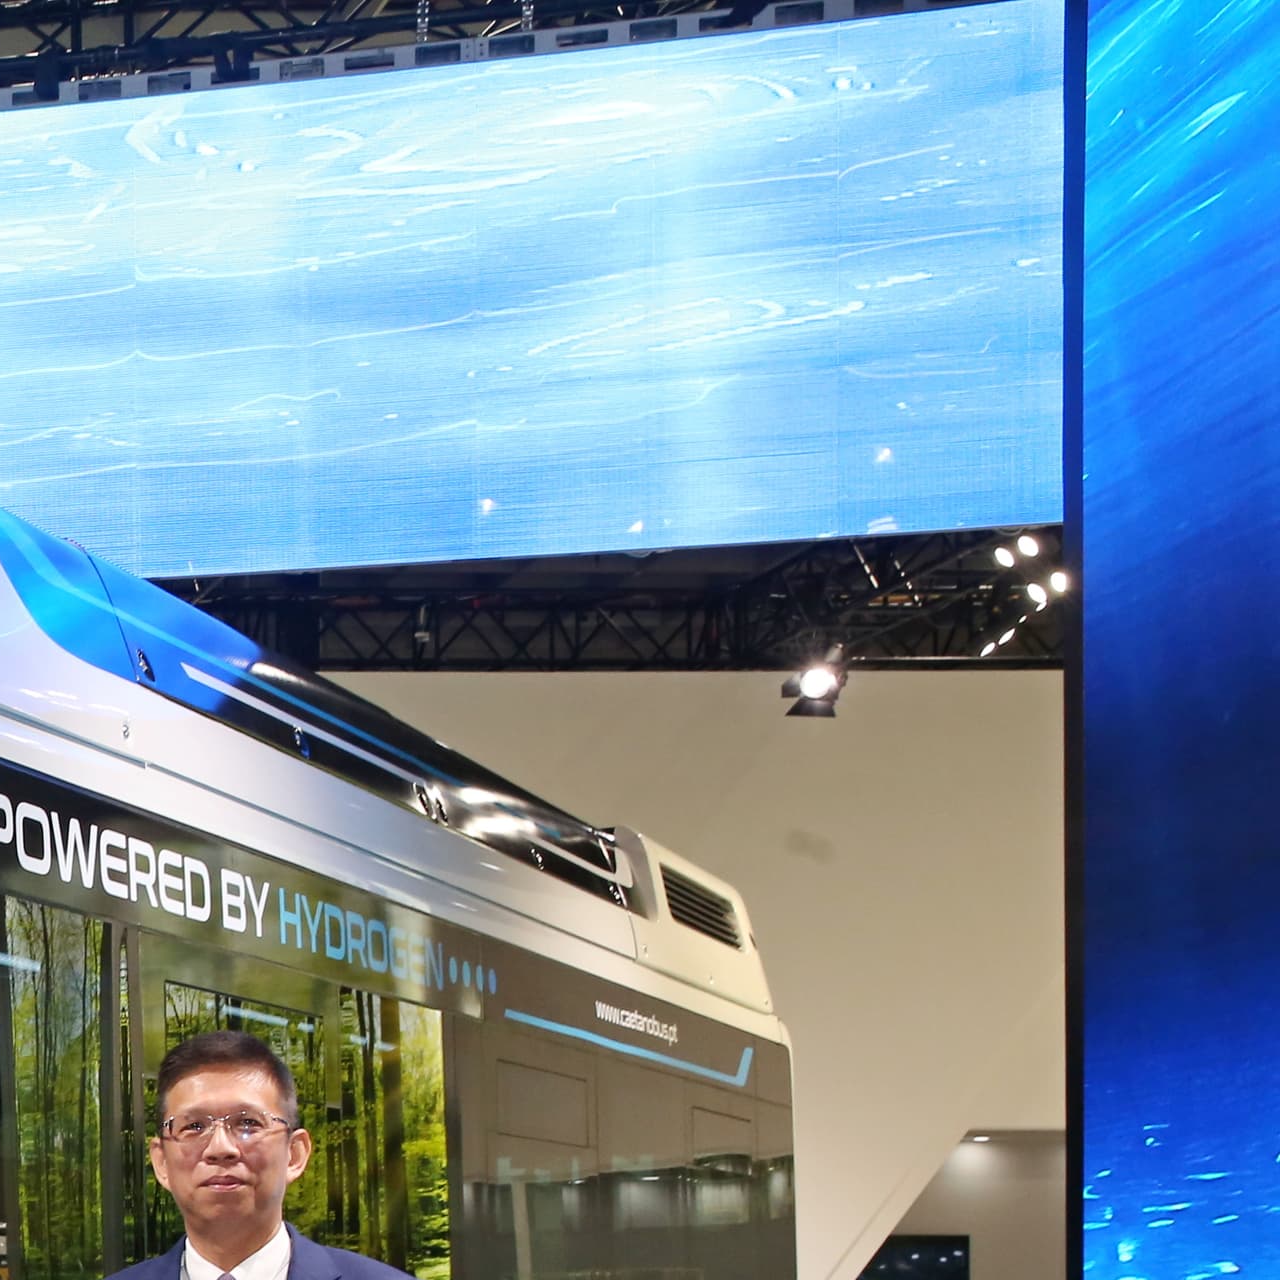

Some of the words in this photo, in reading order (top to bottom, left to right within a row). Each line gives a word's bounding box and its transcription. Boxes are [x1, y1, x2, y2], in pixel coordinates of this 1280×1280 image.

[220, 867, 271, 938] BY
[278, 887, 444, 991] HYDROGEN
[594, 1000, 679, 1047] www.caetanobus.pt
